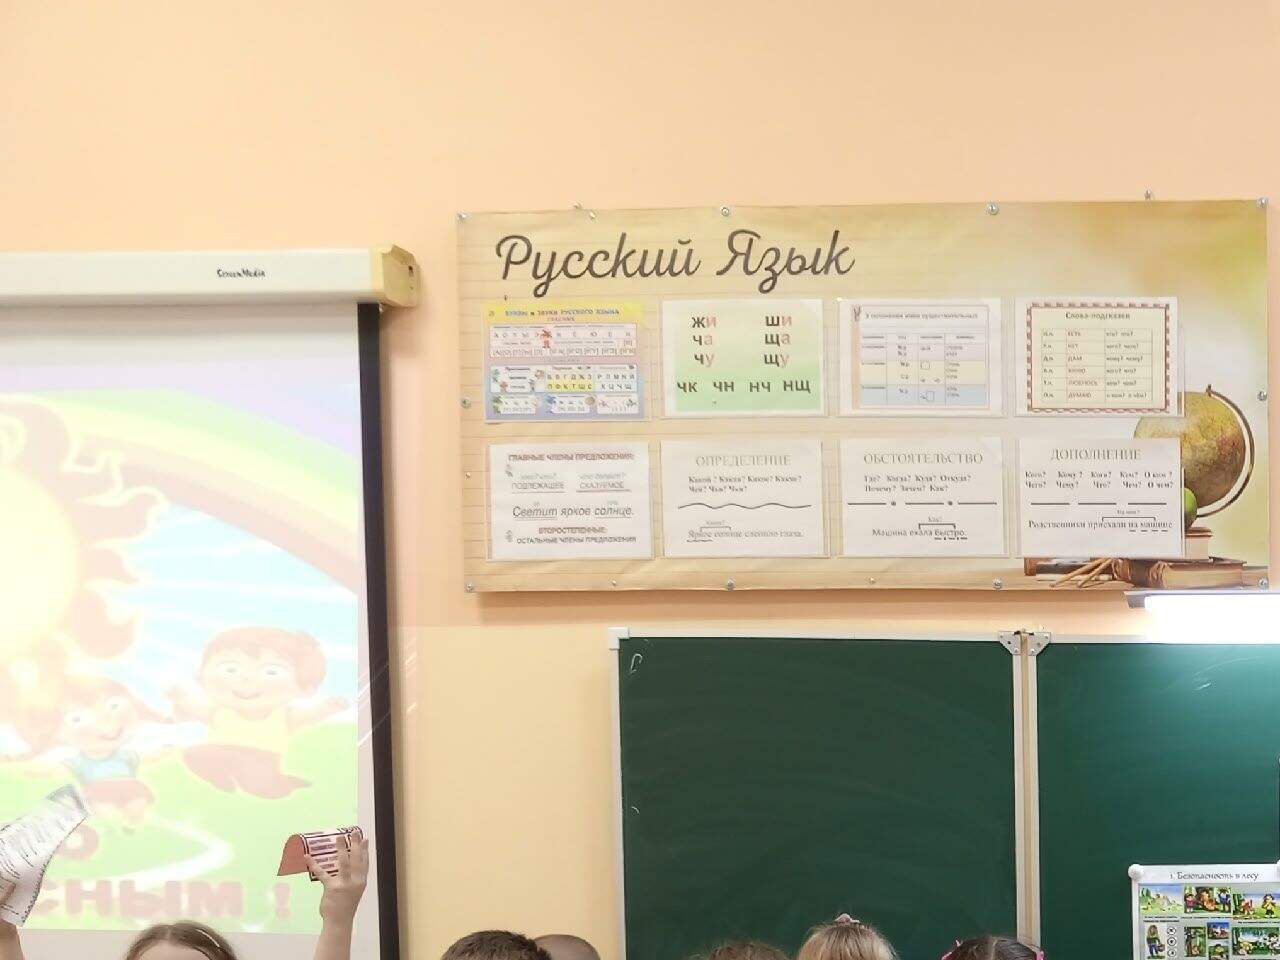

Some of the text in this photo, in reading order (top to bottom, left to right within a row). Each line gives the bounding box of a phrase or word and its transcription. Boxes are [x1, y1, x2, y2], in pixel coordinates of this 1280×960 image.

[495, 230, 855, 297] Русский Язык
[692, 316, 792, 328] жи ши
[693, 334, 791, 346] ча ща
[695, 354, 789, 368] чу щу
[677, 380, 811, 393] чк чн нч нщ
[863, 454, 983, 464] ОБСТОЯТЕЛЬСТВО
[1051, 449, 1142, 461] ДОПОЛНЕНИЕ
[513, 507, 557, 517] Светит
[561, 508, 590, 517] яркое
